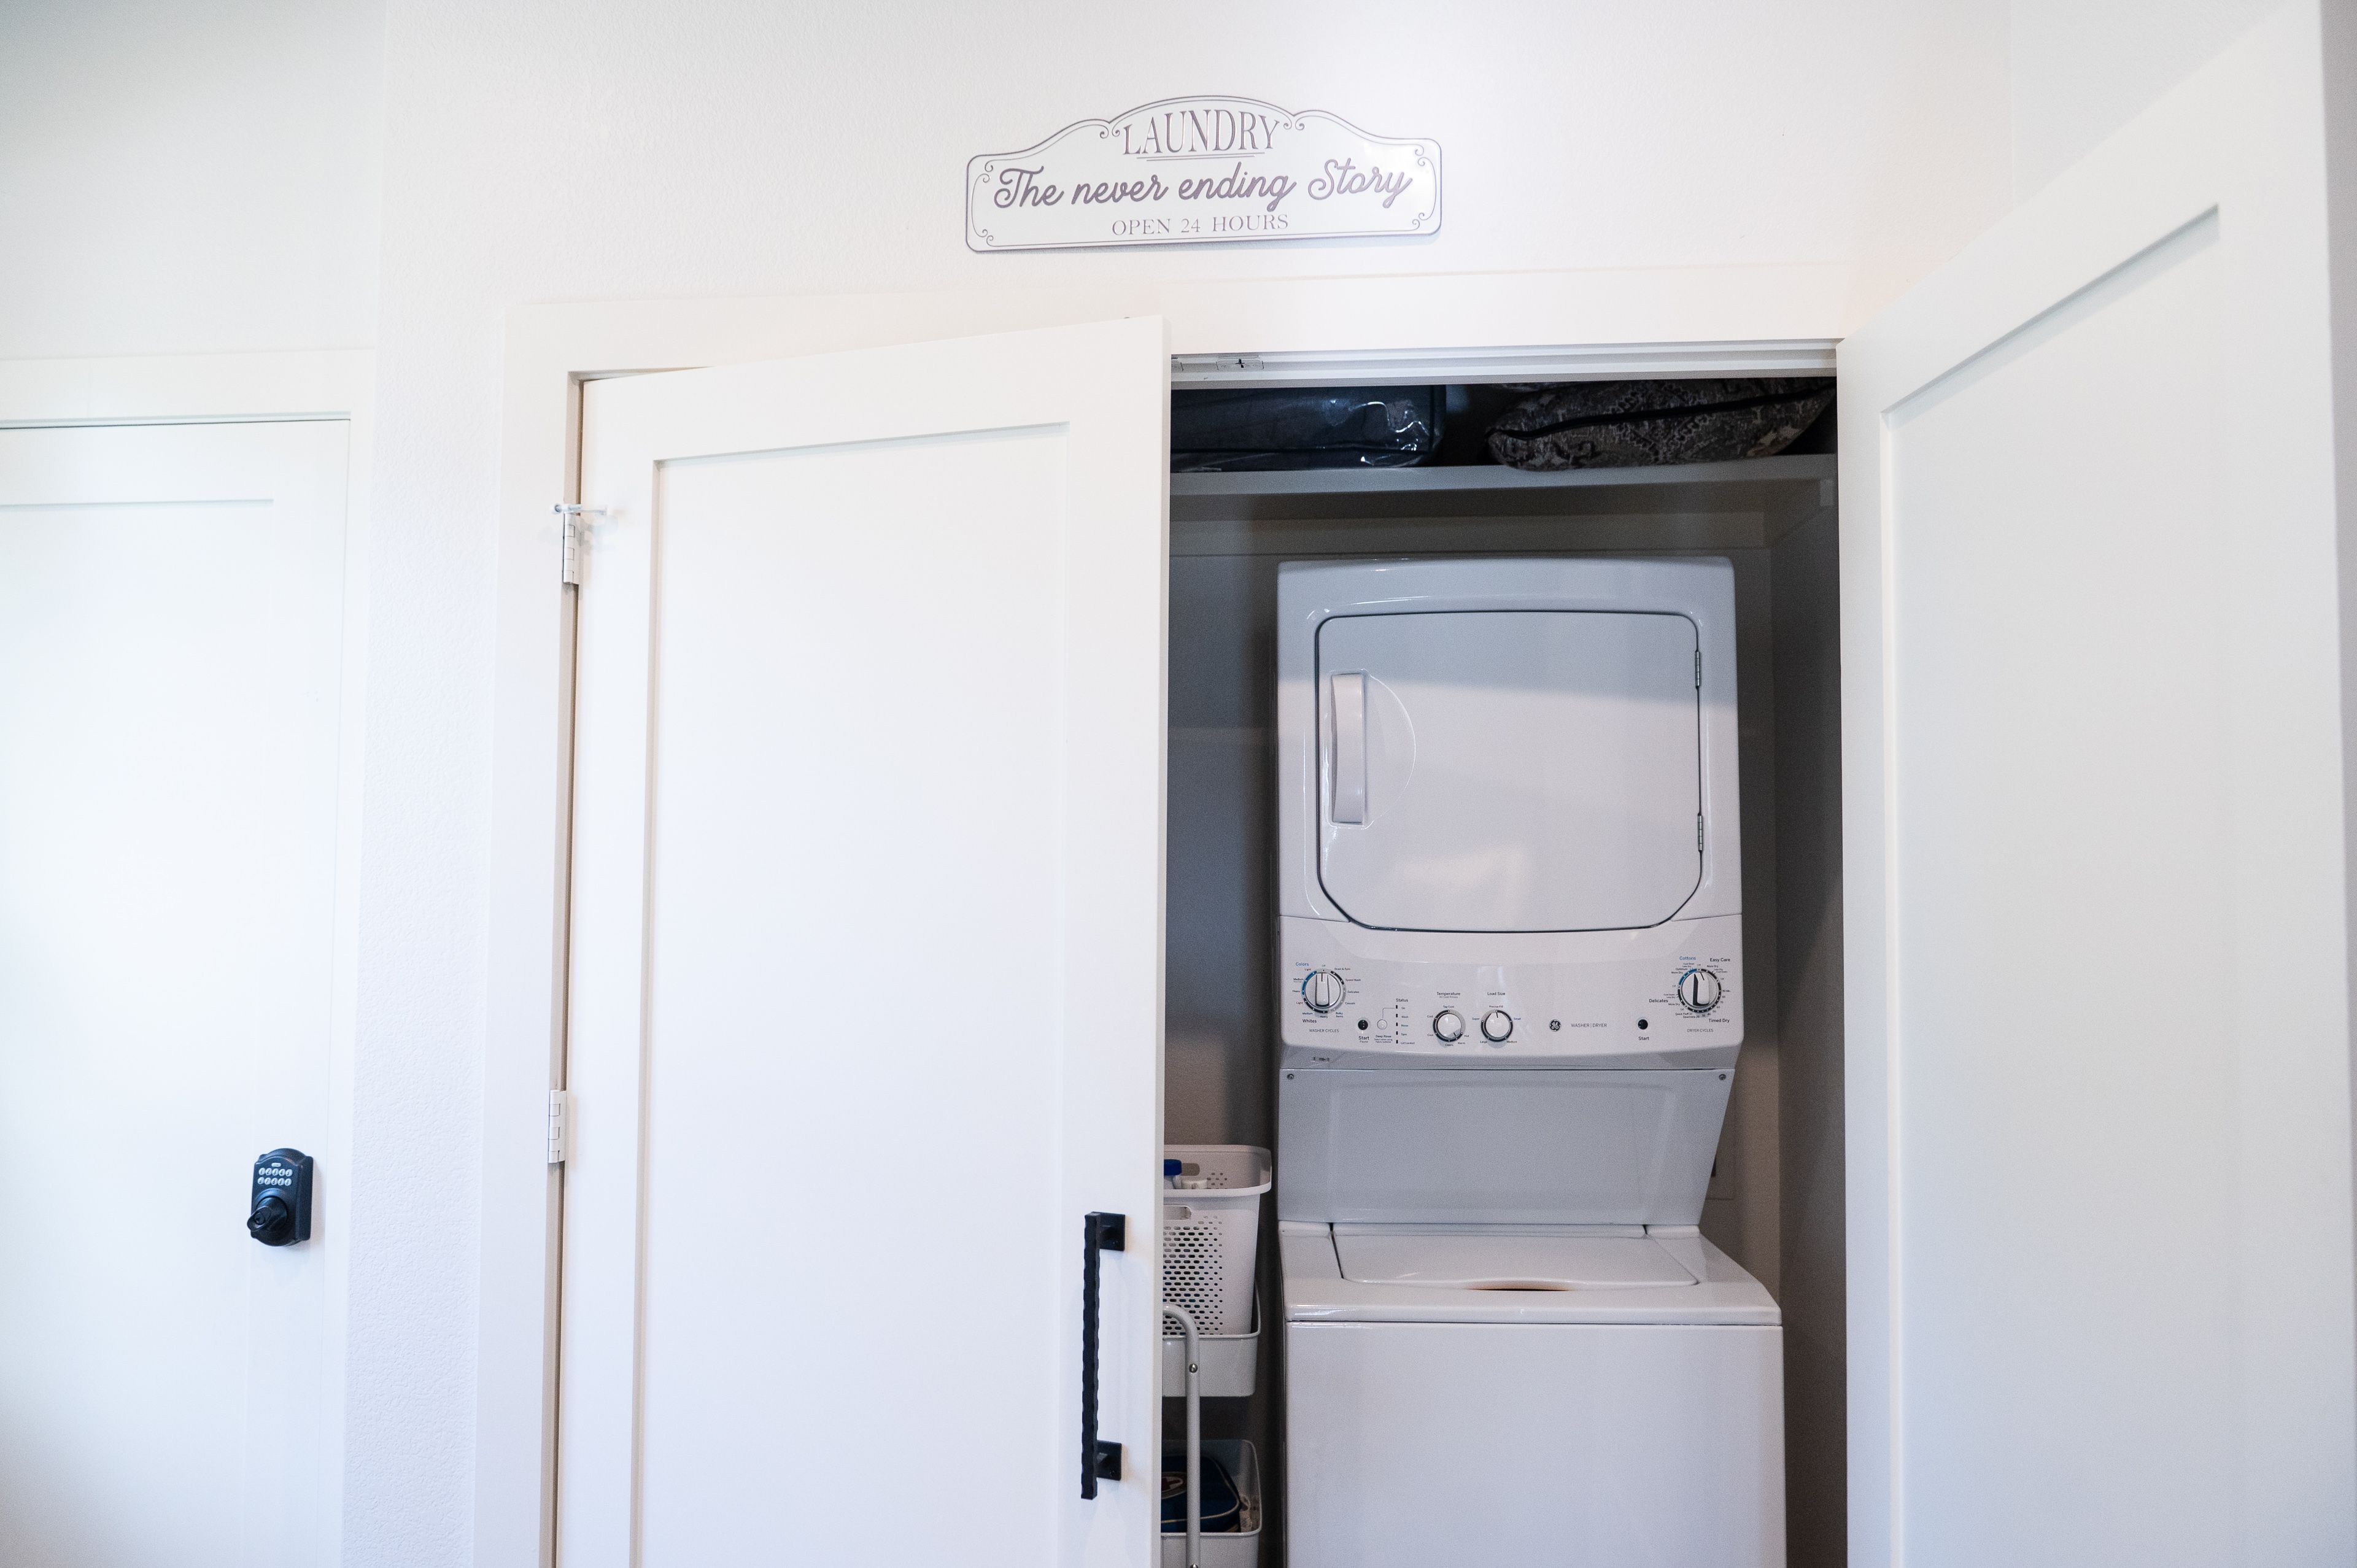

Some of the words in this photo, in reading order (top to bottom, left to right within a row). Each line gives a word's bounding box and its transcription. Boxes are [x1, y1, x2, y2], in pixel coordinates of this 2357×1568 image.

[1123, 109, 1280, 155] LAUNDRY
[994, 166, 1064, 208] The
[1071, 174, 1169, 205] never
[1178, 161, 1297, 212] ending
[1308, 158, 1413, 209] Story
[1112, 218, 1171, 236] OPEN
[1181, 218, 1201, 233] 24
[1212, 214, 1288, 231] HOURS
